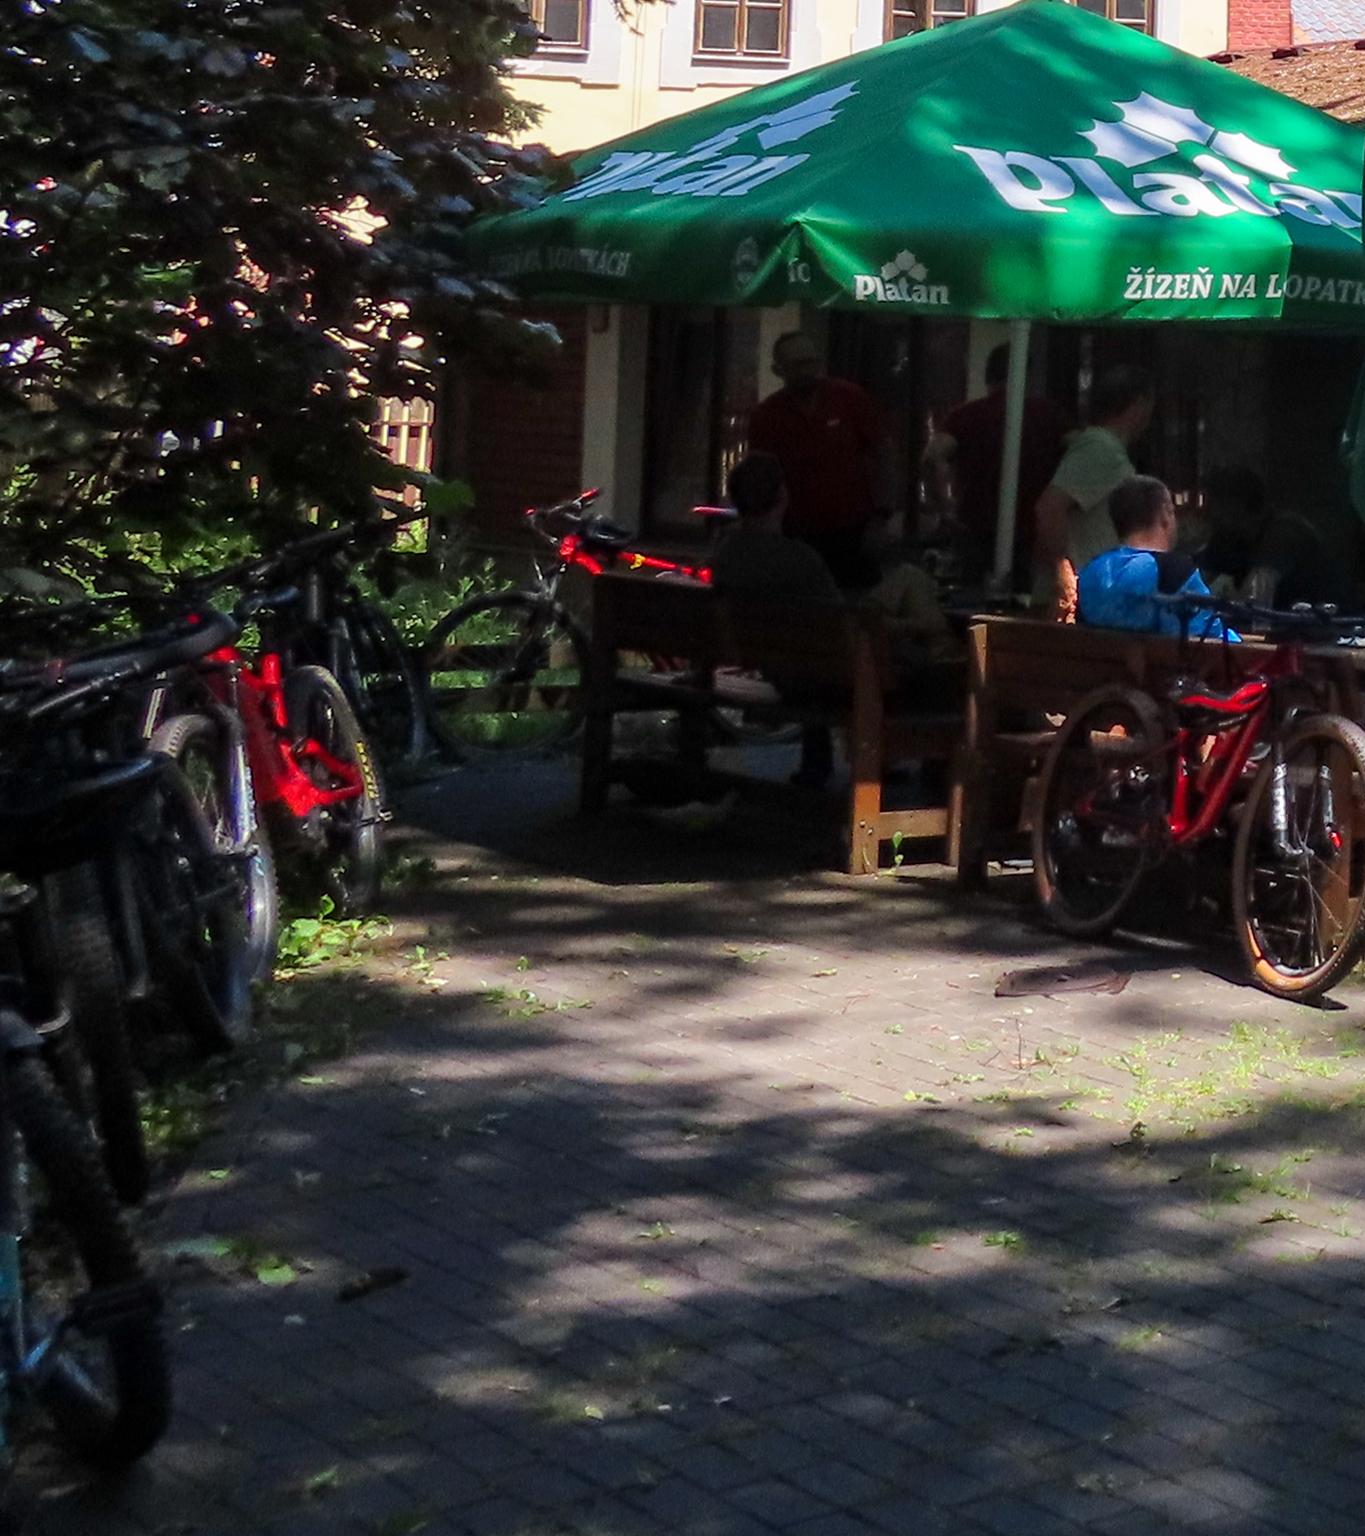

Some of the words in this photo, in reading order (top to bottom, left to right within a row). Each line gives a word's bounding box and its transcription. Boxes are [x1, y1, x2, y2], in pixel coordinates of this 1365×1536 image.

[853, 274, 951, 304] Platan
[1123, 266, 1214, 300] ŽÍZEŇ
[1218, 273, 1257, 299] NA
